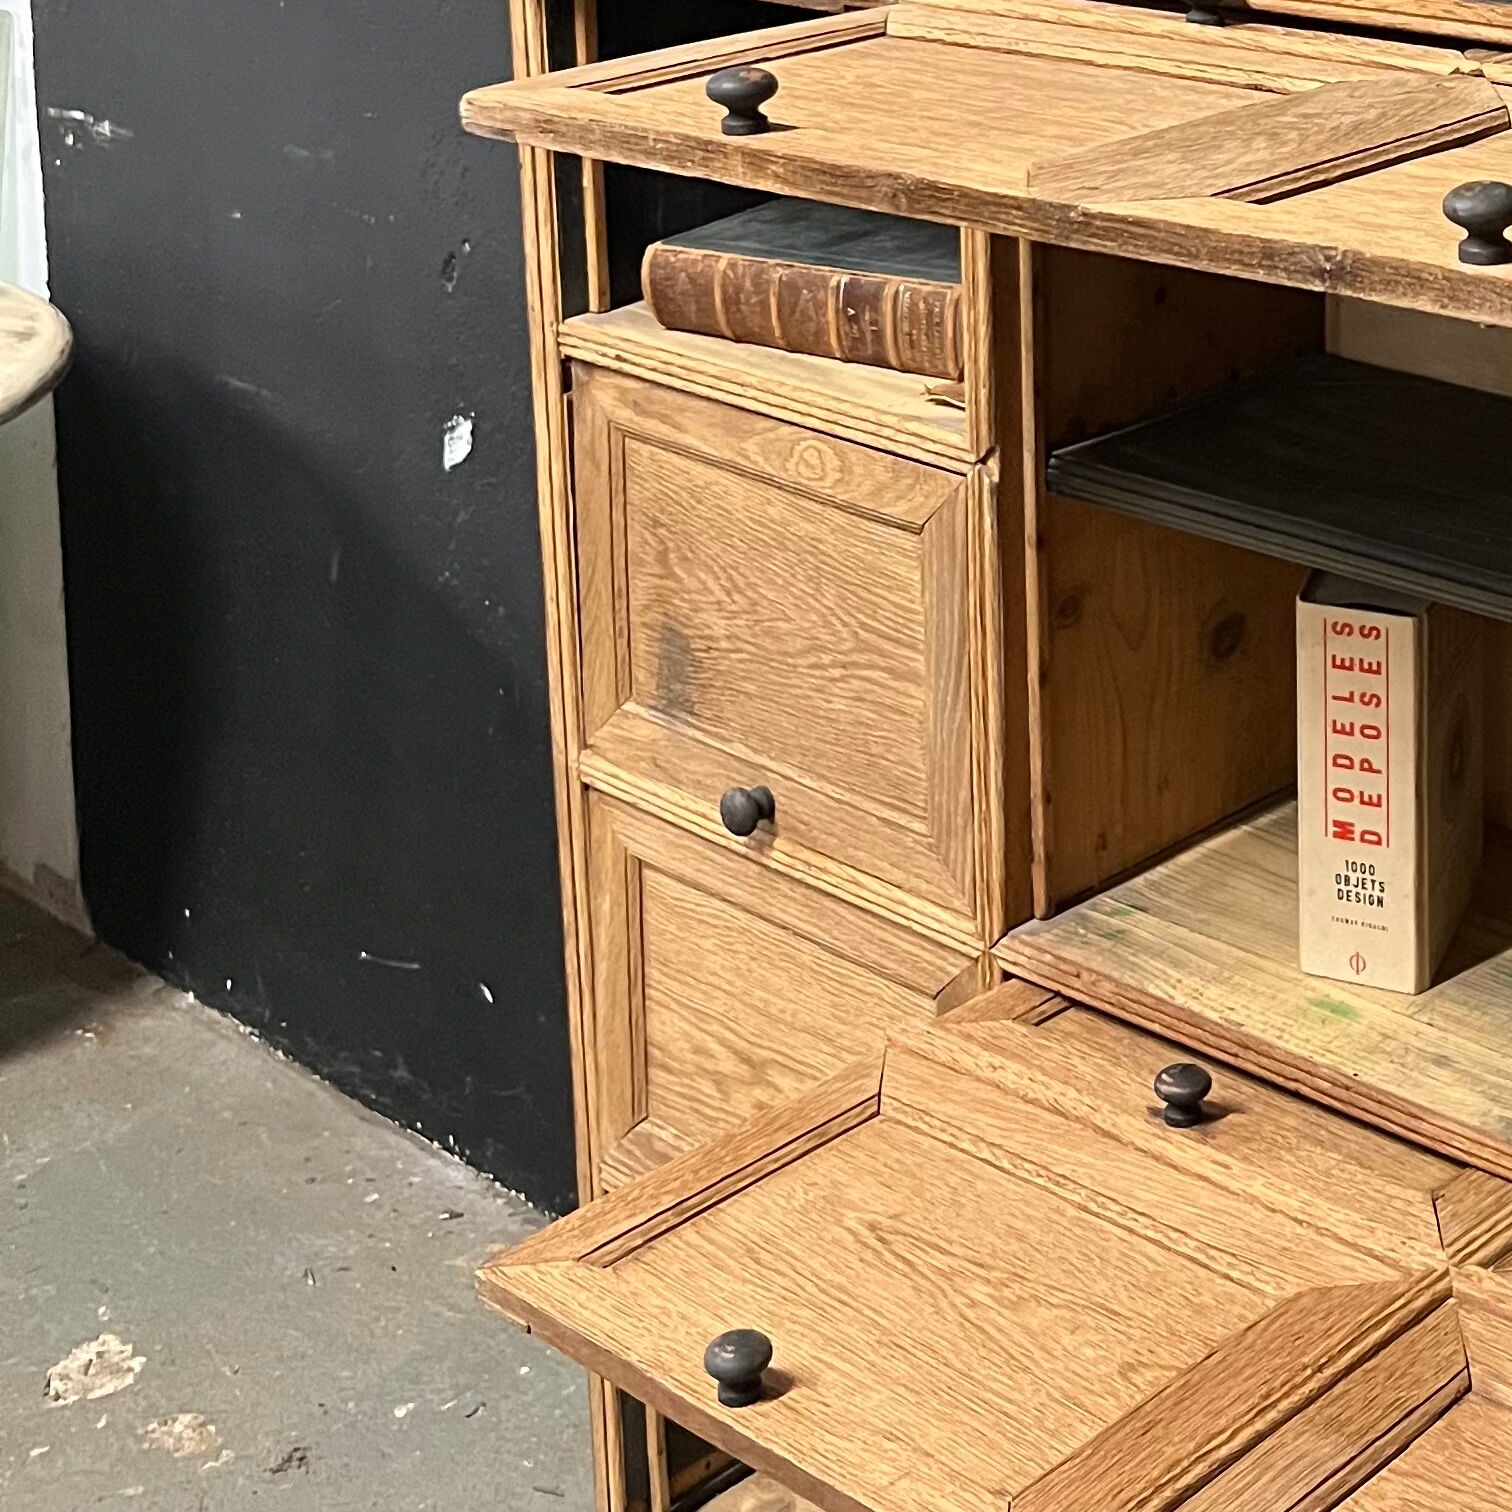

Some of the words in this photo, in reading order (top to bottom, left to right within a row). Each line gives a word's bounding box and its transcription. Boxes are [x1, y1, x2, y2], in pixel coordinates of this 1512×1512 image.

[1345, 859, 1376, 876] 1000
[1335, 873, 1385, 893] OBJETS
[1337, 888, 1384, 908] DESIGN
